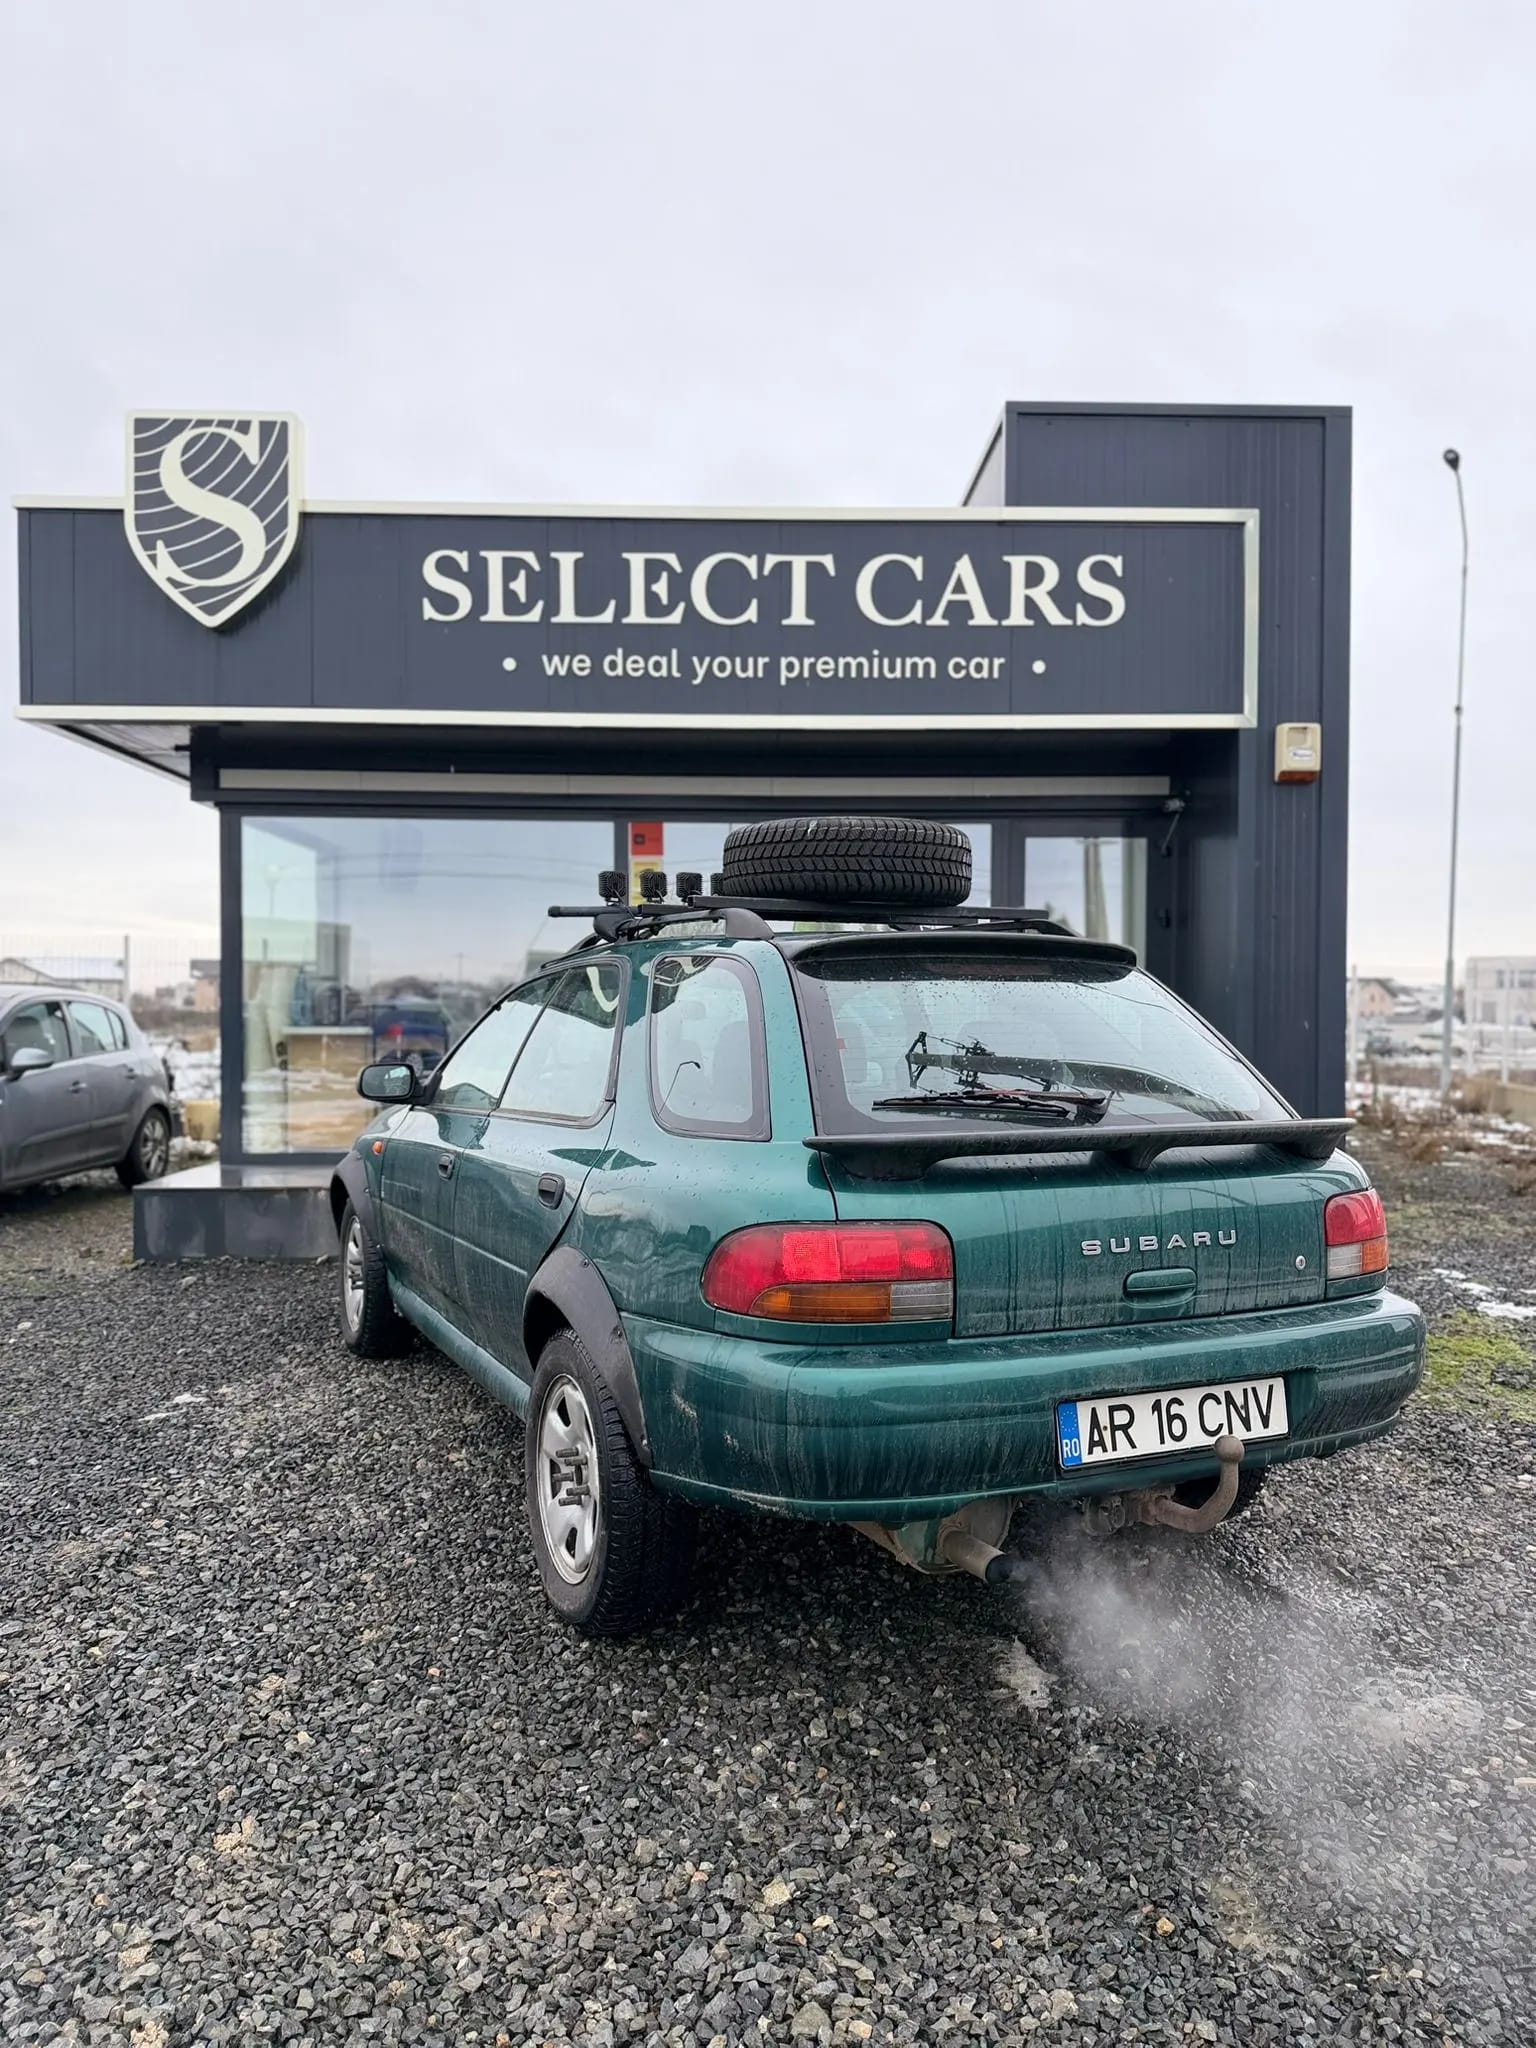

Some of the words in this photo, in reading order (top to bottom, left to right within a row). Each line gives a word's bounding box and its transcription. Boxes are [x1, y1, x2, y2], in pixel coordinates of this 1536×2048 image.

[159, 420, 267, 587] S
[421, 549, 837, 627] SELECT
[854, 553, 1127, 628] CARS
[540, 654, 593, 678] we
[602, 647, 682, 679] deal
[691, 654, 771, 687] your
[780, 648, 938, 688] premium
[947, 656, 1007, 680] car
[1081, 1228, 1238, 1257] SUBARU
[1087, 1403, 1137, 1456] AR
[1151, 1397, 1188, 1445] 16
[1198, 1384, 1274, 1438] CNV
[1062, 1438, 1080, 1459] RO
